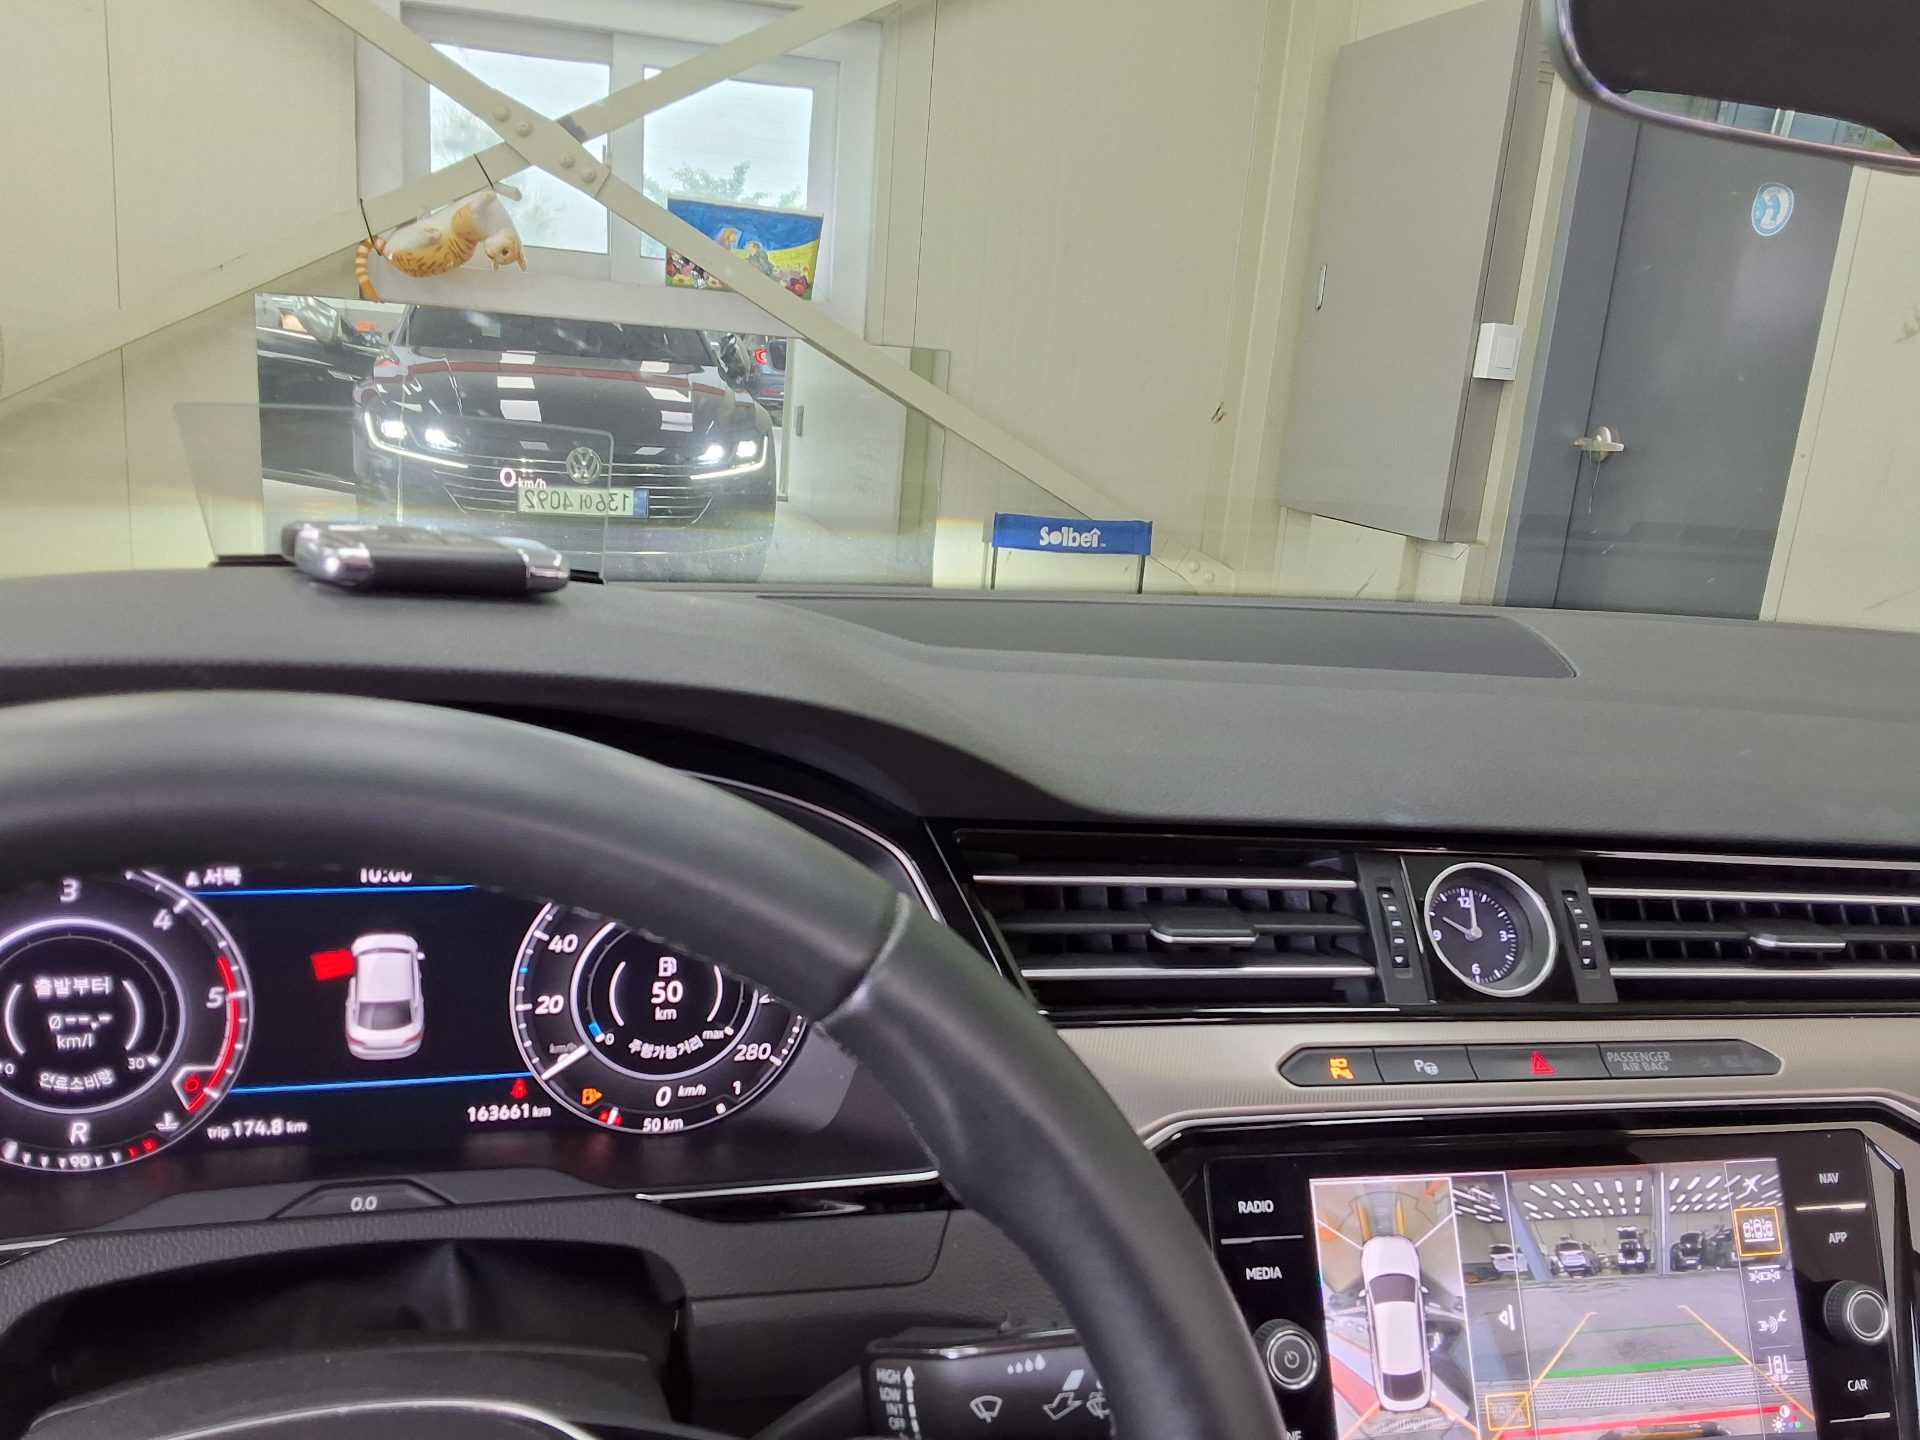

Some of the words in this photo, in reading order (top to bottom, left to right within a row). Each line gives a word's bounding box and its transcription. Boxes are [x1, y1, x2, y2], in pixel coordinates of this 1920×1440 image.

[518, 476, 547, 489] km/h
[60, 879, 81, 902] 3
[1457, 897, 1472, 908] 12
[153, 910, 173, 931] 4
[1432, 929, 1443, 942] 9
[1499, 930, 1508, 942] 3
[548, 934, 578, 953] 40
[1471, 963, 1482, 975] 6
[34, 976, 112, 997] 출발부터
[651, 981, 684, 1003] 50
[207, 988, 224, 1008] 5
[535, 996, 564, 1014] 20
[655, 1007, 677, 1021] km
[605, 1033, 615, 1045] 0
[703, 1029, 724, 1040] max
[734, 1043, 772, 1061] 280
[1606, 1051, 1672, 1062] PASSENGER
[127, 1057, 145, 1070] 30
[1622, 1062, 1641, 1072] AIR
[1643, 1062, 1669, 1071] BAG
[39, 1069, 114, 1091] 연료소비량
[656, 1086, 672, 1106] 0
[678, 1084, 706, 1099] km/h
[467, 1104, 530, 1123] 163661
[532, 1105, 552, 1118] km
[207, 1123, 229, 1140] trip
[232, 1119, 283, 1136] 174.8
[286, 1120, 308, 1134] km
[643, 1117, 662, 1132] 50
[664, 1116, 684, 1131] km
[69, 1121, 89, 1145] R
[70, 1155, 91, 1168] 90
[1818, 1172, 1840, 1185] NAV
[1237, 1200, 1274, 1214] RADIO
[1828, 1232, 1848, 1244] APP
[1246, 1266, 1283, 1281] MEDIA
[1847, 1379, 1869, 1392] CAR
[879, 1386, 901, 1402] LOW
